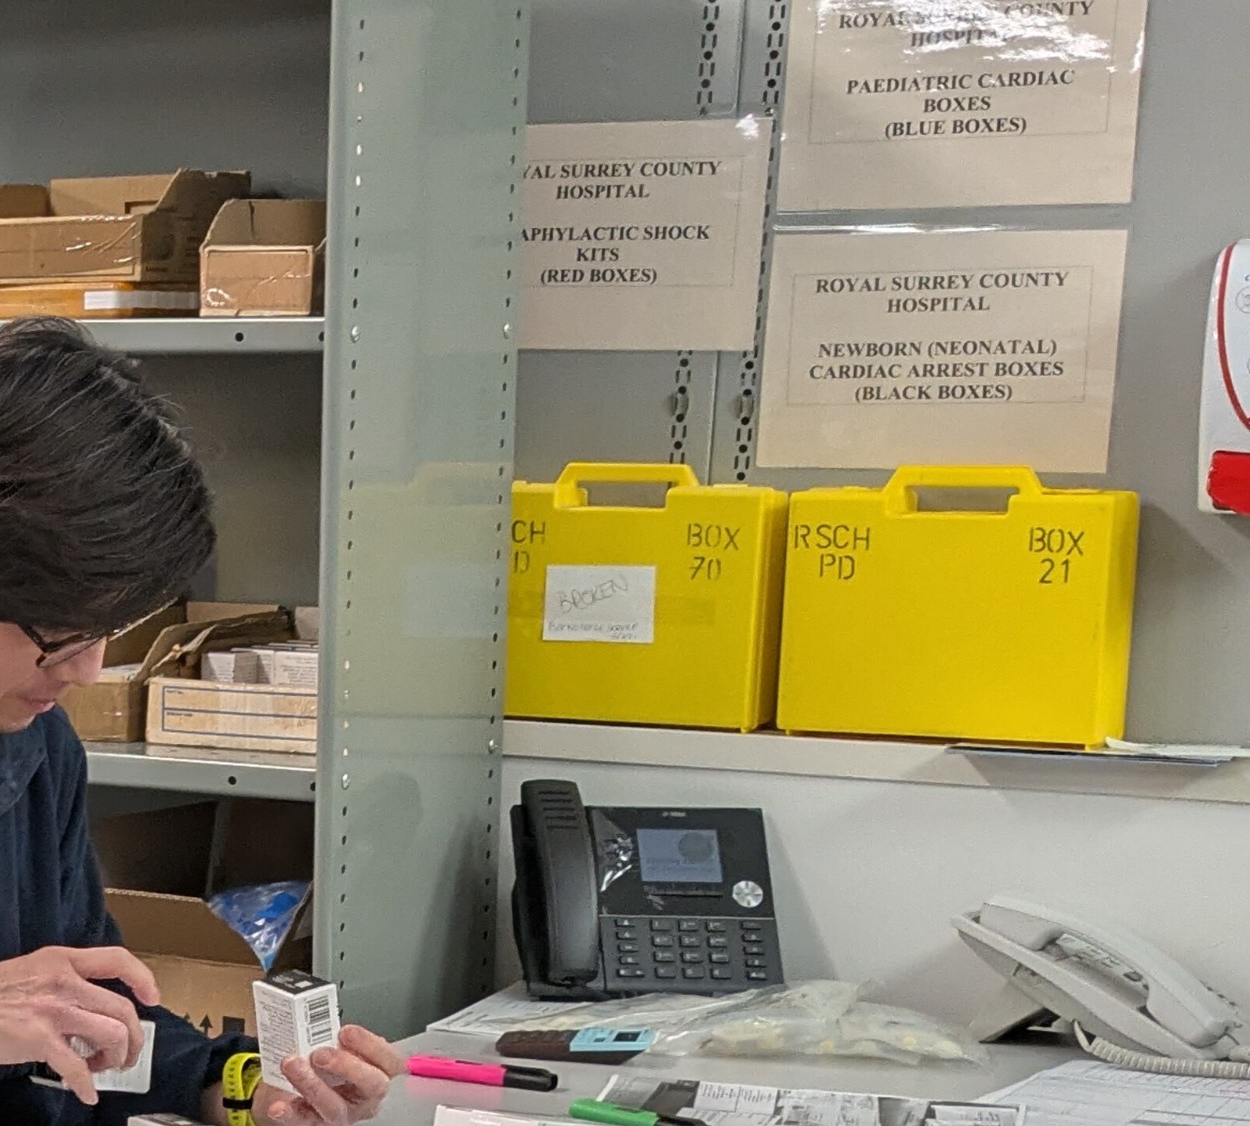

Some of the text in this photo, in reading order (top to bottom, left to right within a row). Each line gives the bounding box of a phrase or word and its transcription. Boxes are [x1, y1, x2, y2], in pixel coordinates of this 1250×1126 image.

[846, 69, 1075, 95] PAEDIATRIC CARDIAC
[923, 95, 991, 114] BOXES
[884, 117, 1028, 141] (BLUE BOXES)
[559, 162, 636, 179] SURREY
[640, 161, 722, 177] COUNTY
[556, 183, 650, 200] HOSPITAL
[642, 225, 711, 240] SHOCK
[576, 247, 620, 262] KITS
[540, 268, 658, 285] (RED BOXES)
[815, 271, 1069, 294] ROYAL SURREY COUNTY
[886, 296, 991, 313] HOSPITAL
[817, 339, 1058, 359] NEWBORN (NEONATAL)
[808, 361, 1064, 380] CARDIAC ARREST BOXES
[854, 384, 1013, 403] (BLACK BOXES)
[686, 522, 741, 551] BOX
[793, 523, 1086, 558] RSCH BOX
[688, 556, 722, 581] 70
[818, 552, 1073, 586] PD 21
